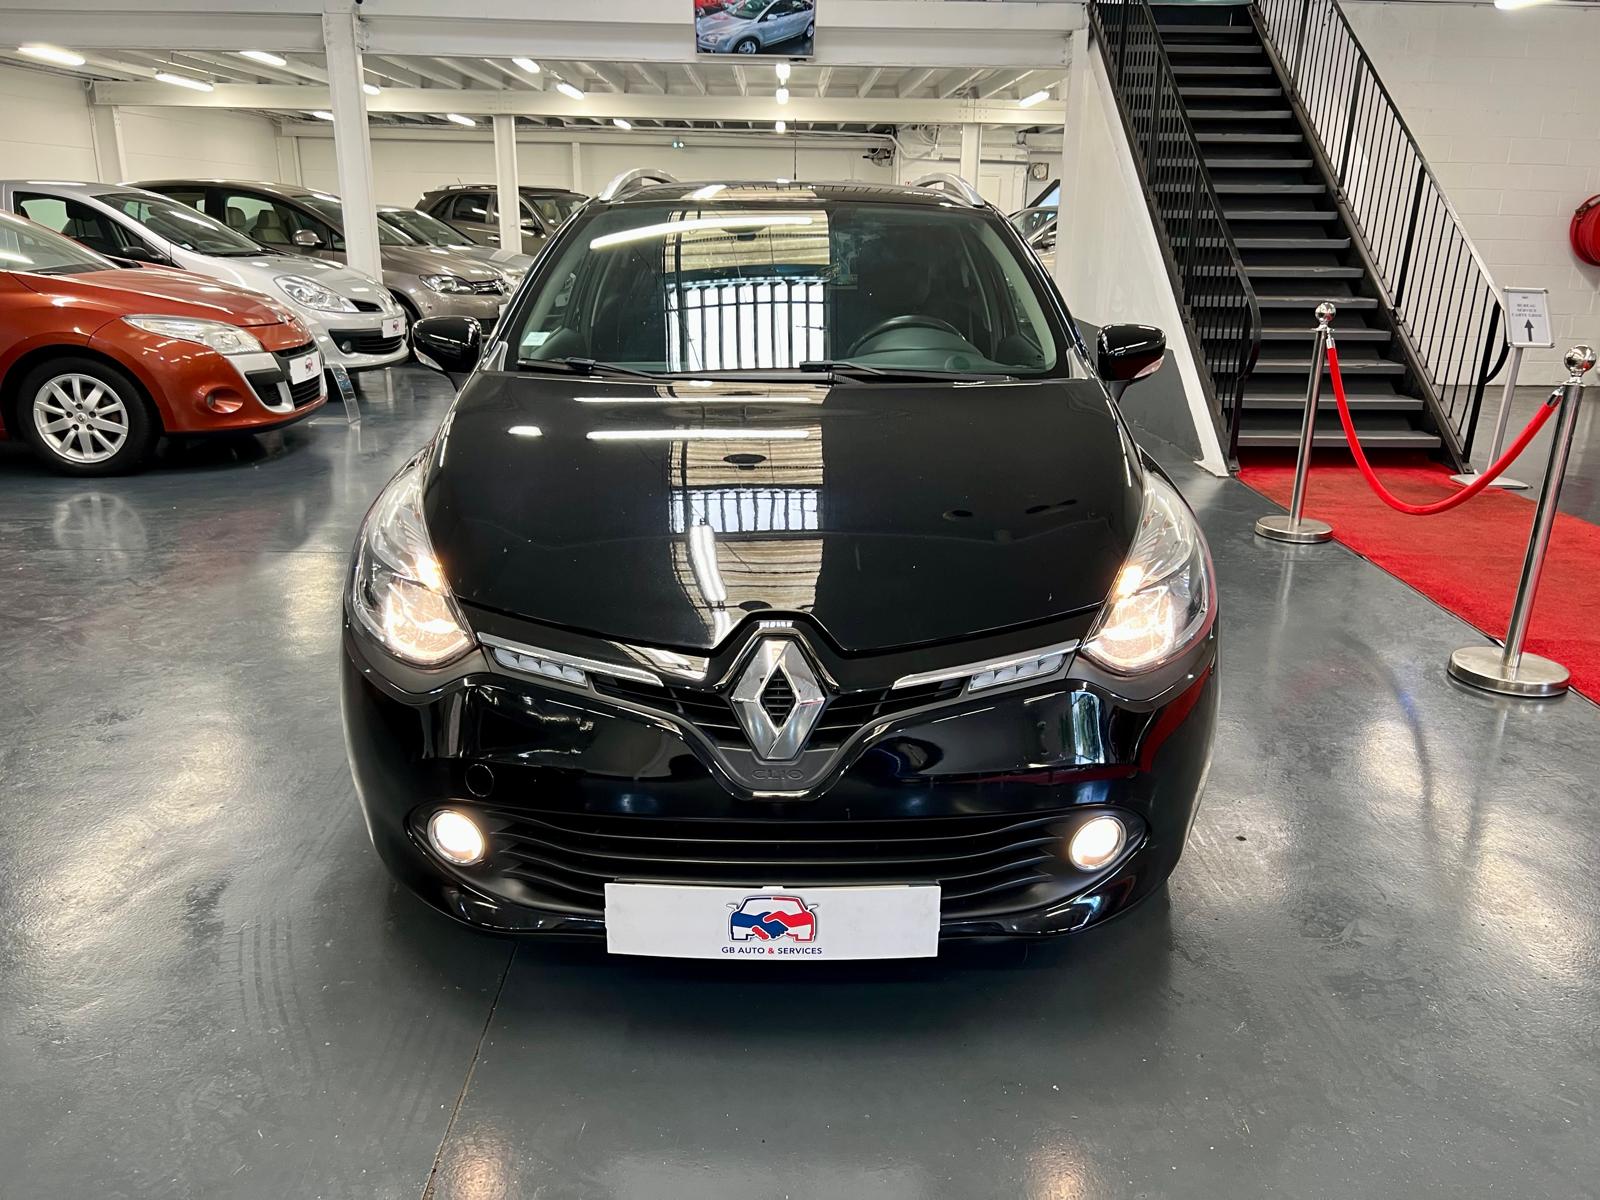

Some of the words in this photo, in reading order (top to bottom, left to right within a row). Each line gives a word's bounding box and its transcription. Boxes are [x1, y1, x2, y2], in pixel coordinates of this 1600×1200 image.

[752, 769, 804, 780] CLIO
[721, 946, 735, 954] GB
[738, 947, 765, 955] AUTO
[767, 947, 775, 955] &
[777, 947, 822, 955] SERVICES
